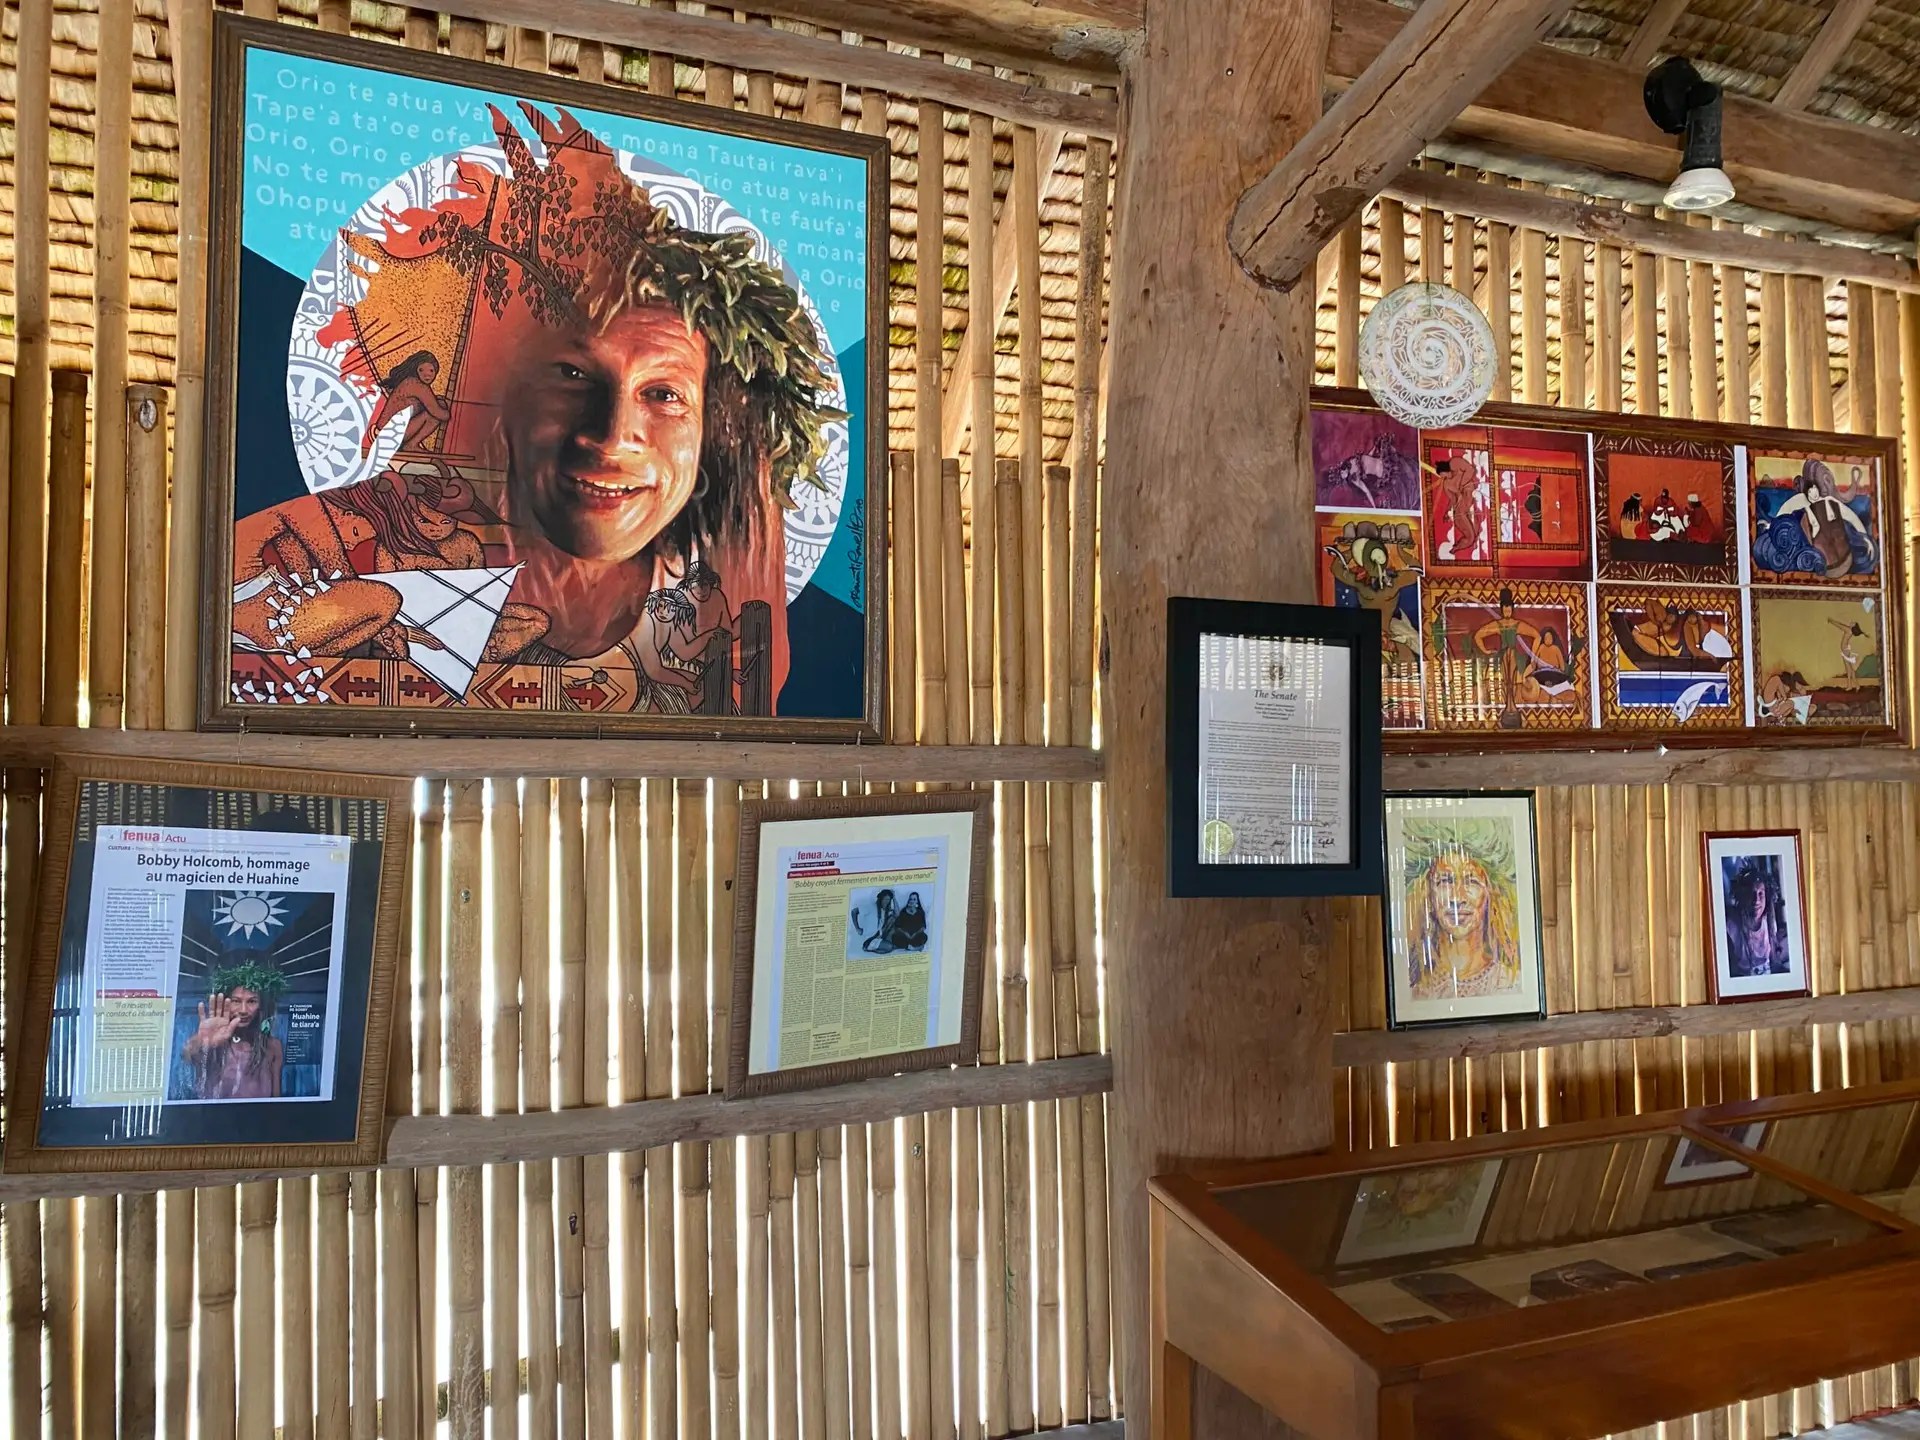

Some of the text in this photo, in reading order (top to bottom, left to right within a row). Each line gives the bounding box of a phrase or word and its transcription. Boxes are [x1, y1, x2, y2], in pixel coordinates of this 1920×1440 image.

[276, 69, 336, 96] Orio
[348, 81, 374, 102] te
[387, 91, 443, 115] atua
[621, 131, 698, 160] moana
[708, 146, 776, 172] Tautai
[784, 161, 843, 184] rava'i
[252, 93, 340, 125] Tape'a
[353, 111, 419, 138] ta'oe
[431, 124, 471, 147] ofe
[742, 180, 789, 201] atua
[799, 190, 866, 213] vahine
[246, 122, 316, 154] Orio,
[328, 136, 388, 164] Orio
[399, 148, 413, 165] e
[761, 208, 781, 225] te
[790, 211, 865, 238] faufa'a
[252, 154, 290, 177] No
[300, 162, 329, 183] te
[798, 243, 866, 264] moana
[256, 184, 347, 216] Ohopu
[820, 269, 866, 290] Orio
[831, 300, 840, 312] e
[1254, 690, 1298, 701] The Senate
[123, 829, 160, 842] fenua
[165, 834, 187, 843] Actu
[137, 854, 310, 873] Bobby Holcomb, hommage
[797, 850, 839, 861] fenua Actu
[145, 870, 299, 886] au magicien de Huahine
[815, 877, 835, 888] croyait
[836, 875, 869, 886] fermement
[870, 875, 879, 883] en
[879, 874, 885, 882] la
